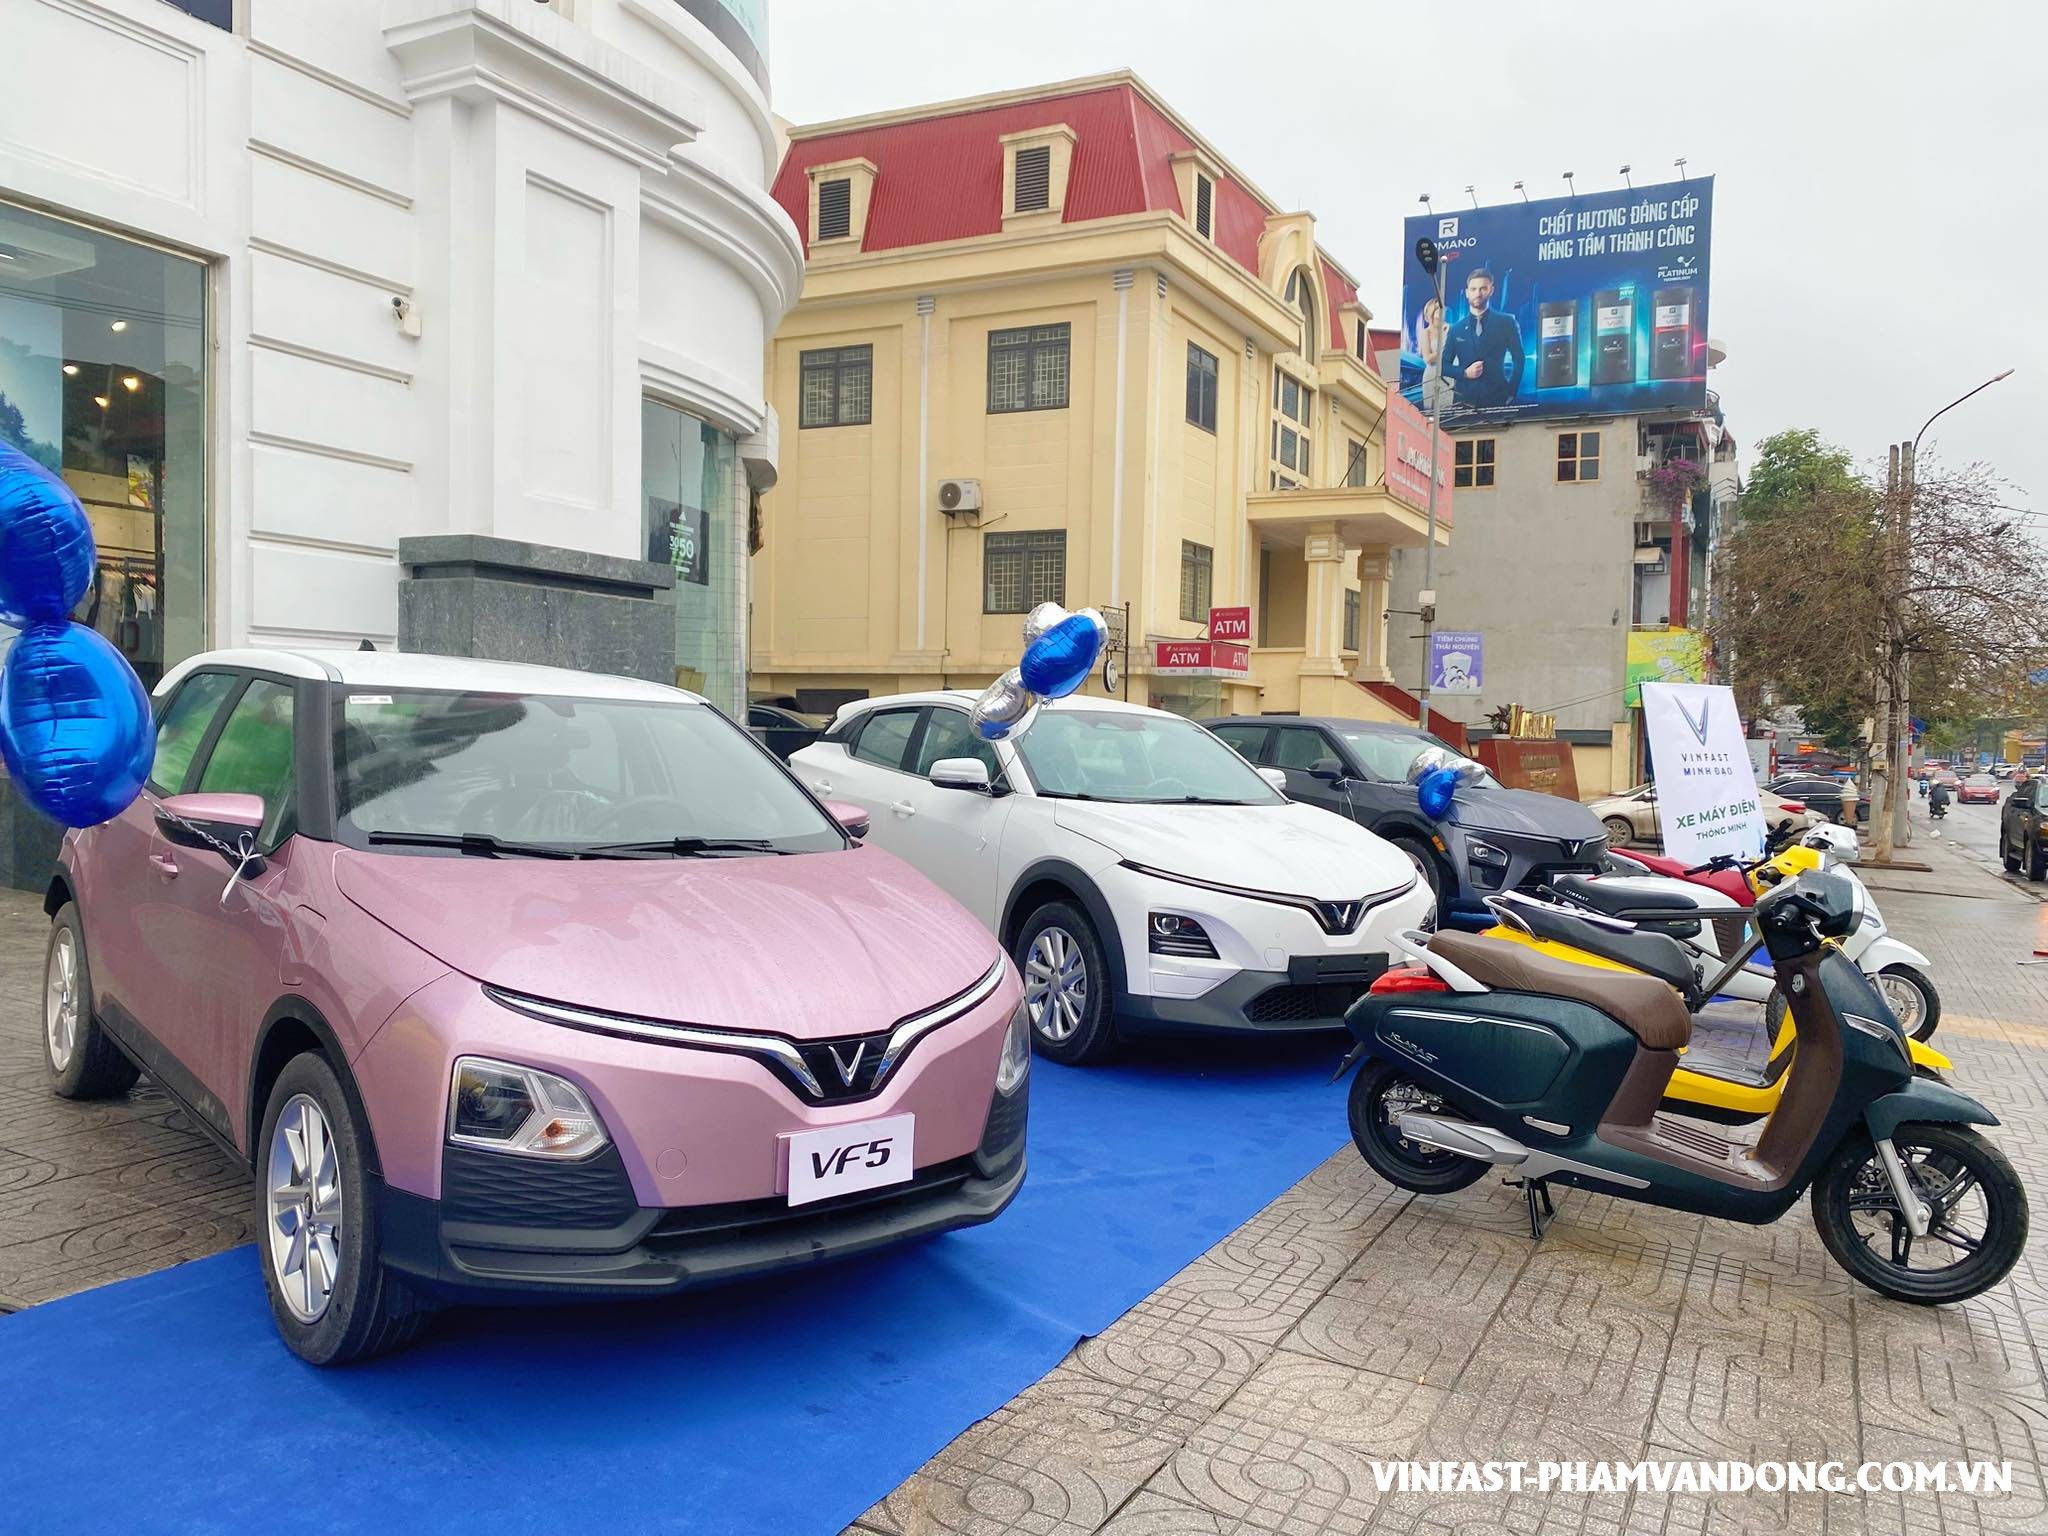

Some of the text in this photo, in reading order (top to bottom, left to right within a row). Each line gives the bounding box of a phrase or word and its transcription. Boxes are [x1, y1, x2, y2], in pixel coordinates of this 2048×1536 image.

[1539, 208, 1573, 236] CHẤT
[1577, 207, 1626, 231] HƯƠNG
[1671, 192, 1699, 219] CẤP
[1433, 237, 1477, 251] MANO
[1538, 239, 1573, 261] NÂNG
[1610, 229, 1653, 253] THÀNH
[1657, 224, 1695, 248] CÔNG
[1657, 267, 1698, 279] PLATINUM
[1214, 620, 1246, 634] ATM
[1169, 652, 1200, 664] ATM
[1232, 651, 1248, 667] ATM
[1681, 753, 1729, 762] VINFAST
[1684, 767, 1711, 776] MINH
[1676, 799, 1756, 829] XE MÁY ĐIỆN
[1696, 821, 1747, 840] THÔNG MINH
